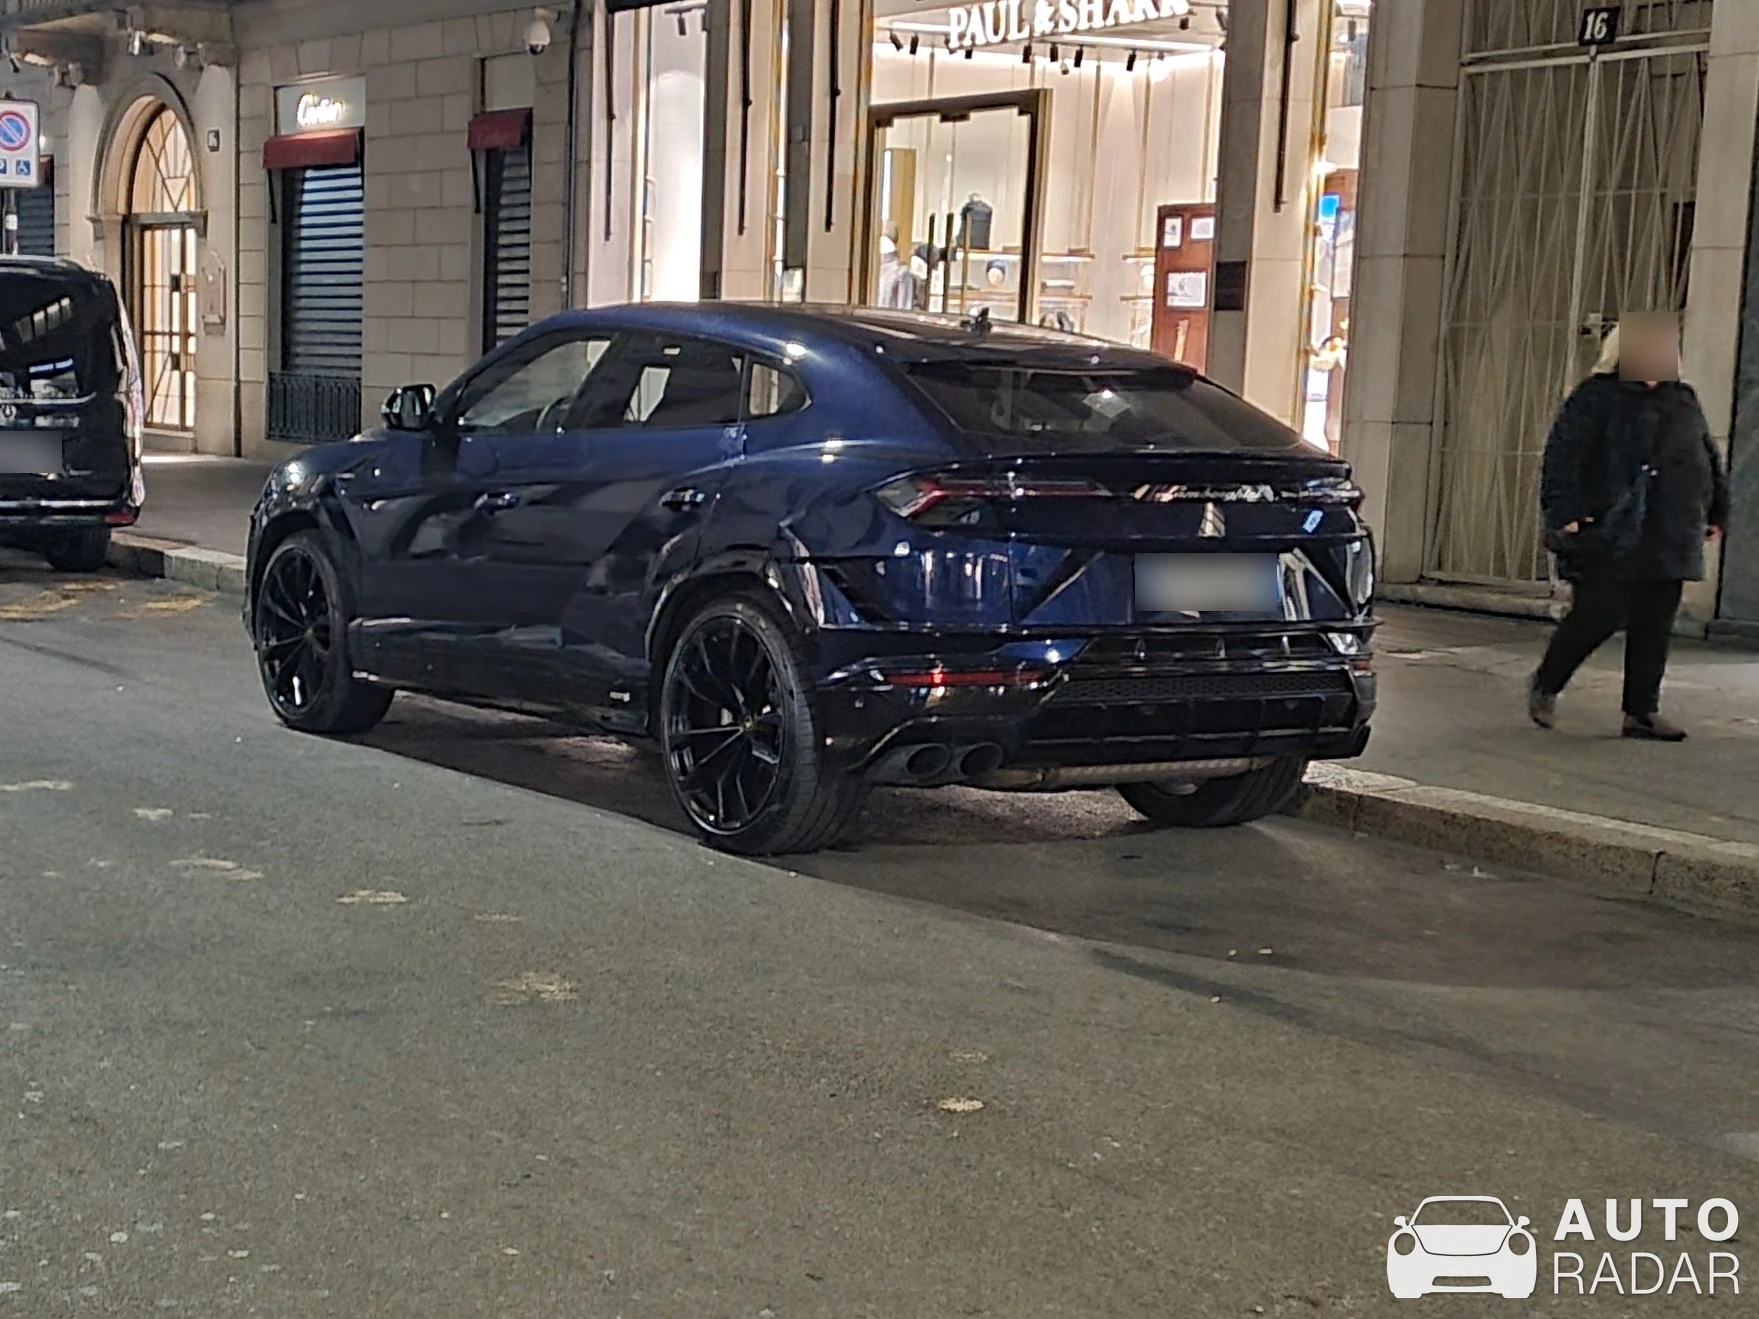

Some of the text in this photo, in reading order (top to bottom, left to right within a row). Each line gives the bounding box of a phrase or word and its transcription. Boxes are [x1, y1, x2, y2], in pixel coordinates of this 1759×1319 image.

[949, 0, 1030, 48] PAUL
[1034, 1, 1055, 37] &
[1583, 11, 1608, 40] 16
